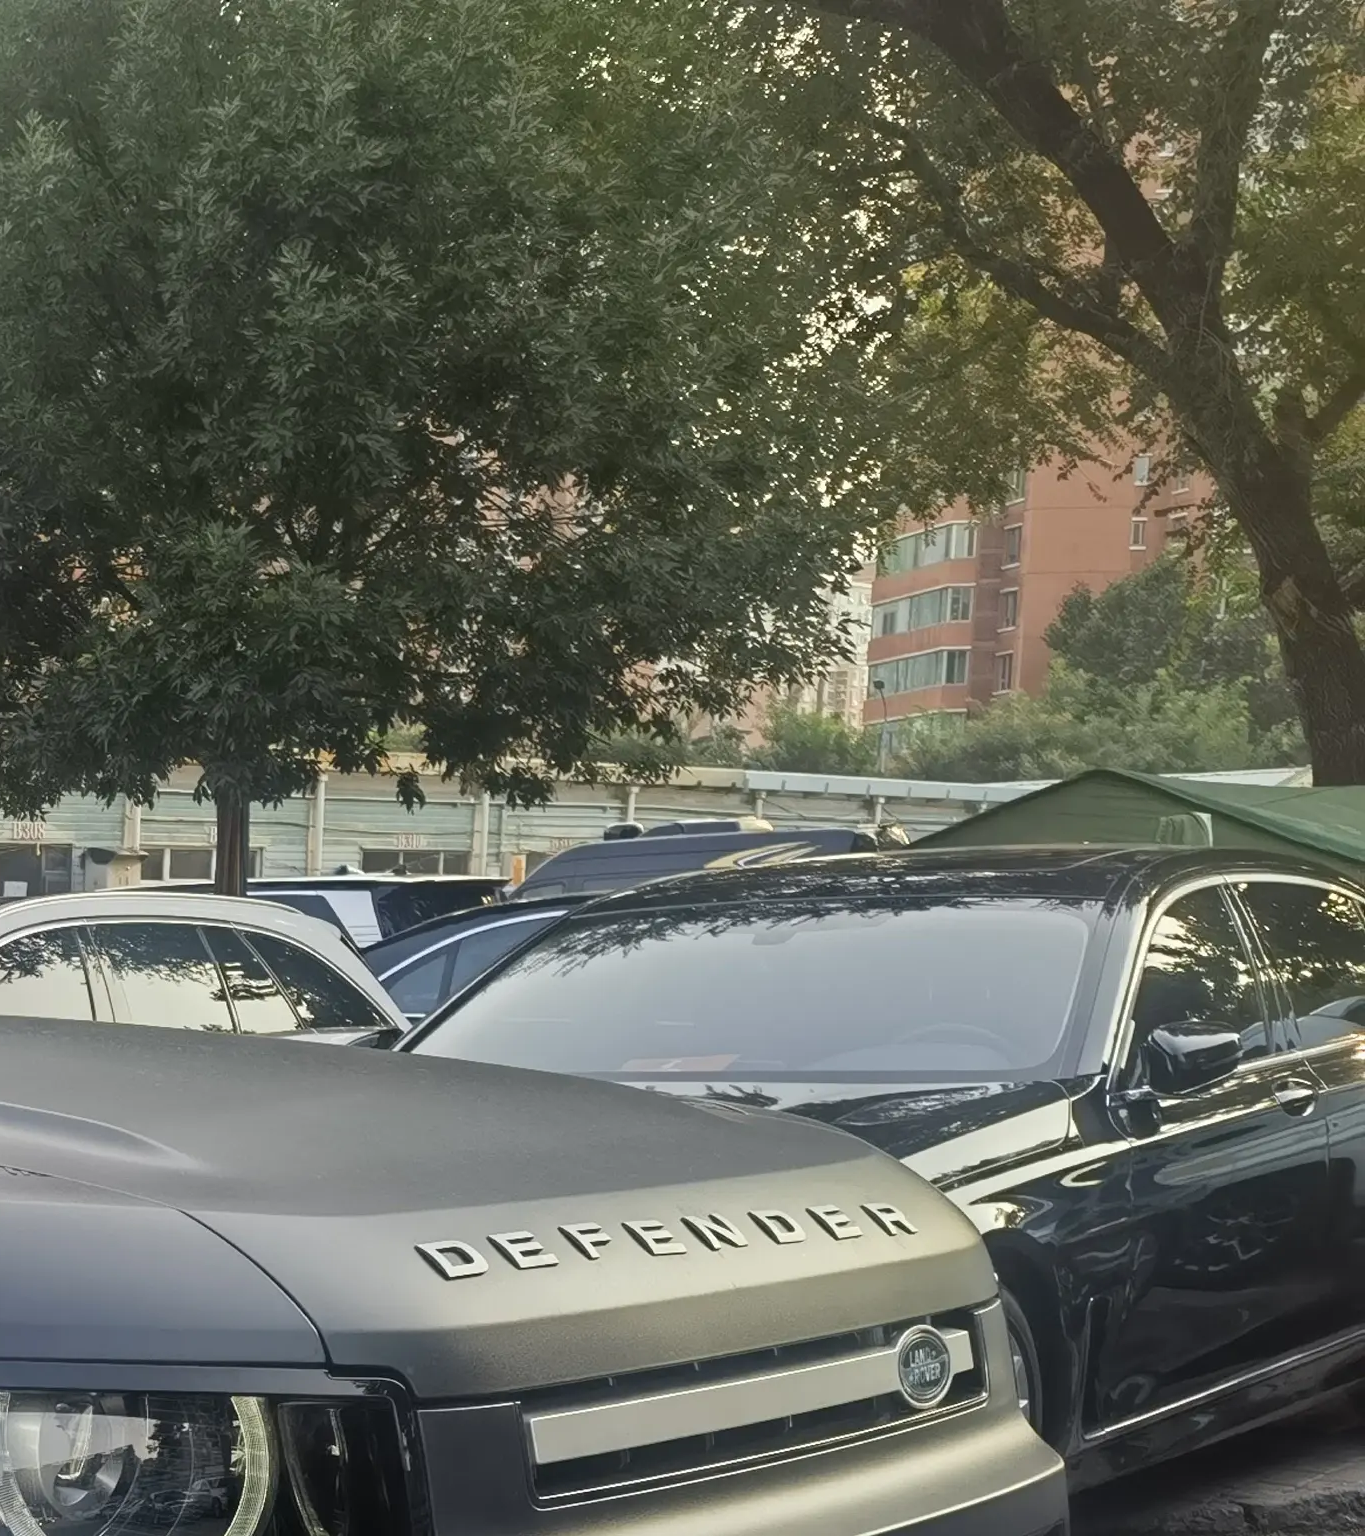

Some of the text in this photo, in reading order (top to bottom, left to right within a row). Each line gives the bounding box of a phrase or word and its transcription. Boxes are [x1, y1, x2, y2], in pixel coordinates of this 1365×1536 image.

[414, 1202, 918, 1281] DEFENDER
[909, 1346, 932, 1368] LAND
[914, 1363, 941, 1385] ROVER
